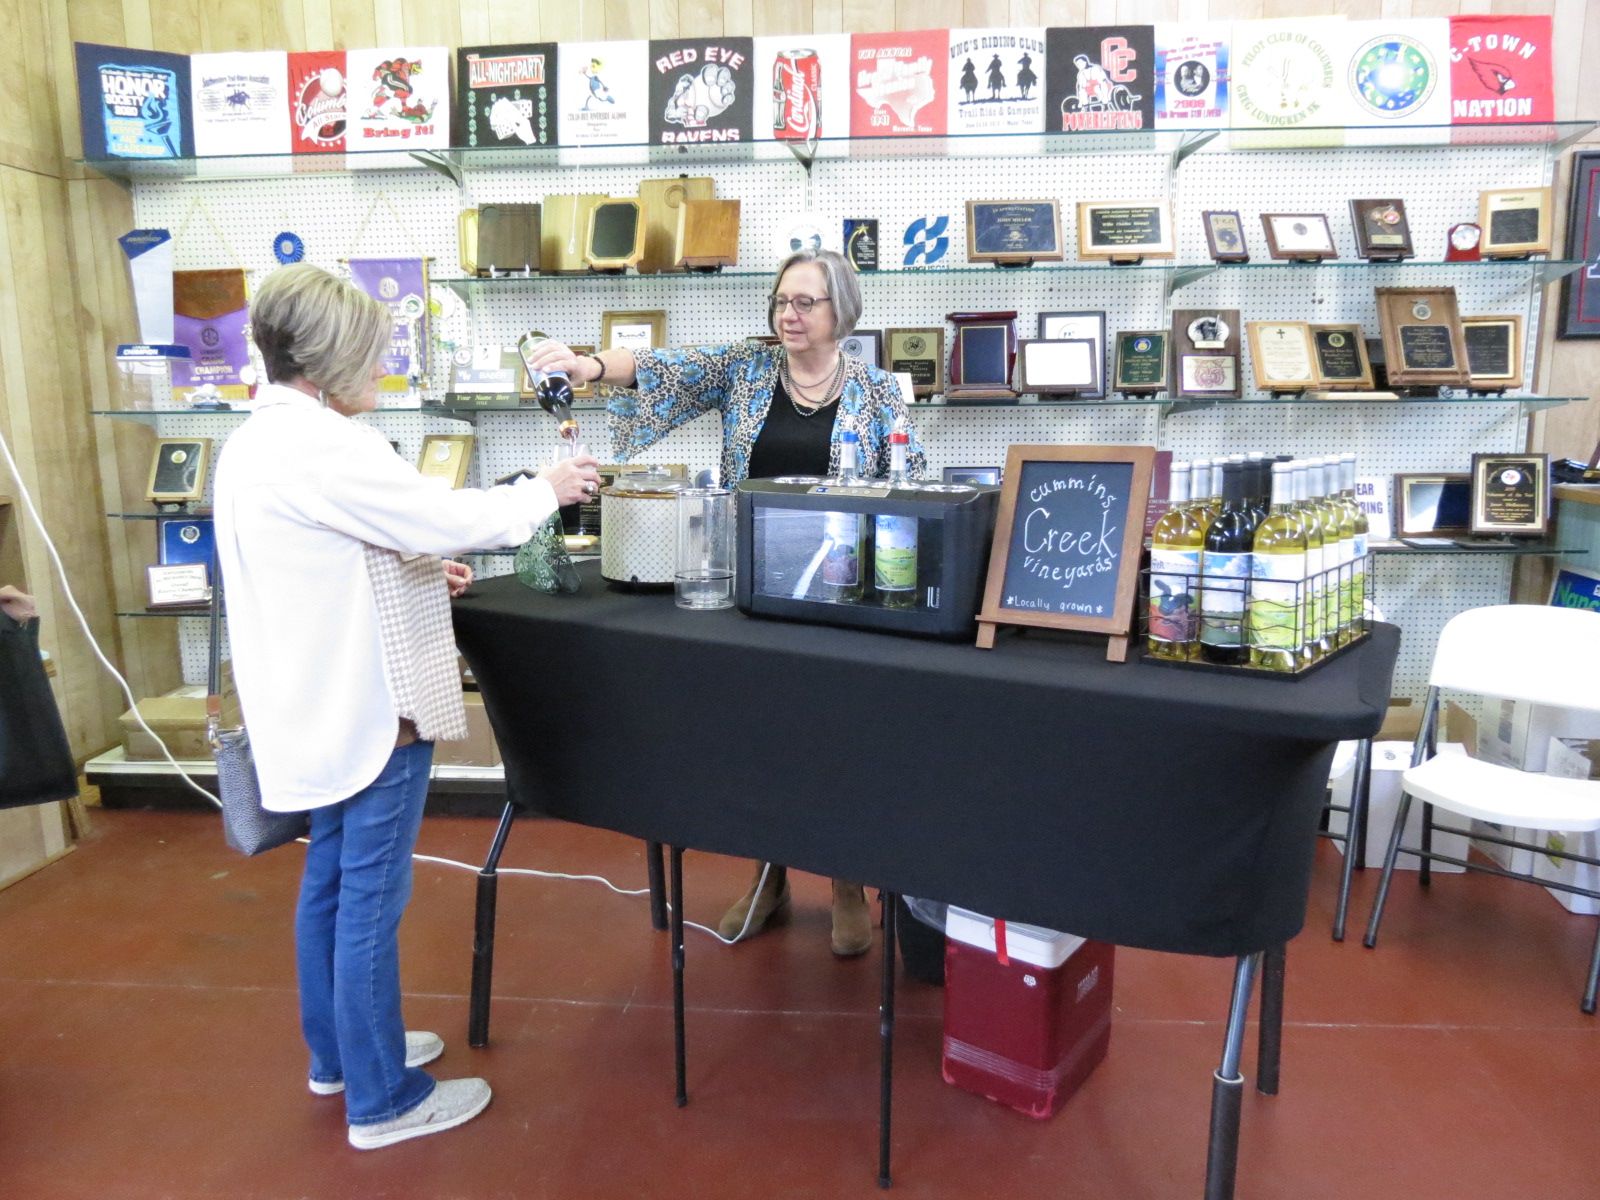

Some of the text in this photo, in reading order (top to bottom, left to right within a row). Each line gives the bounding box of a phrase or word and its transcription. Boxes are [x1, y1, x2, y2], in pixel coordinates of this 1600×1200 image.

[981, 35, 1016, 49] RIDING
[1019, 37, 1044, 54] CLUB
[1451, 33, 1537, 62] C-TOWN
[656, 46, 745, 74] RED EYE
[1241, 40, 1265, 67] PILOT
[1267, 32, 1292, 45] CLUB
[1295, 33, 1308, 44] OF
[1308, 40, 1334, 88] COLUMBUS
[471, 58, 545, 85] ALL-NIGHT-PARTY
[102, 75, 166, 98] HONOR
[105, 94, 144, 106] SOCIETY
[1454, 98, 1532, 118] NATION
[958, 108, 978, 118] Trail
[979, 107, 996, 117] Ride
[1063, 111, 1142, 131] POWERLIFTING
[363, 124, 434, 139] Bring It!
[661, 128, 741, 144] RAVENS
[195, 366, 233, 375] CHAMPION
[1030, 474, 1117, 508] cummins
[1356, 482, 1374, 496] EAR
[1024, 507, 1117, 558] Creek
[1024, 556, 1112, 588] vineyards
